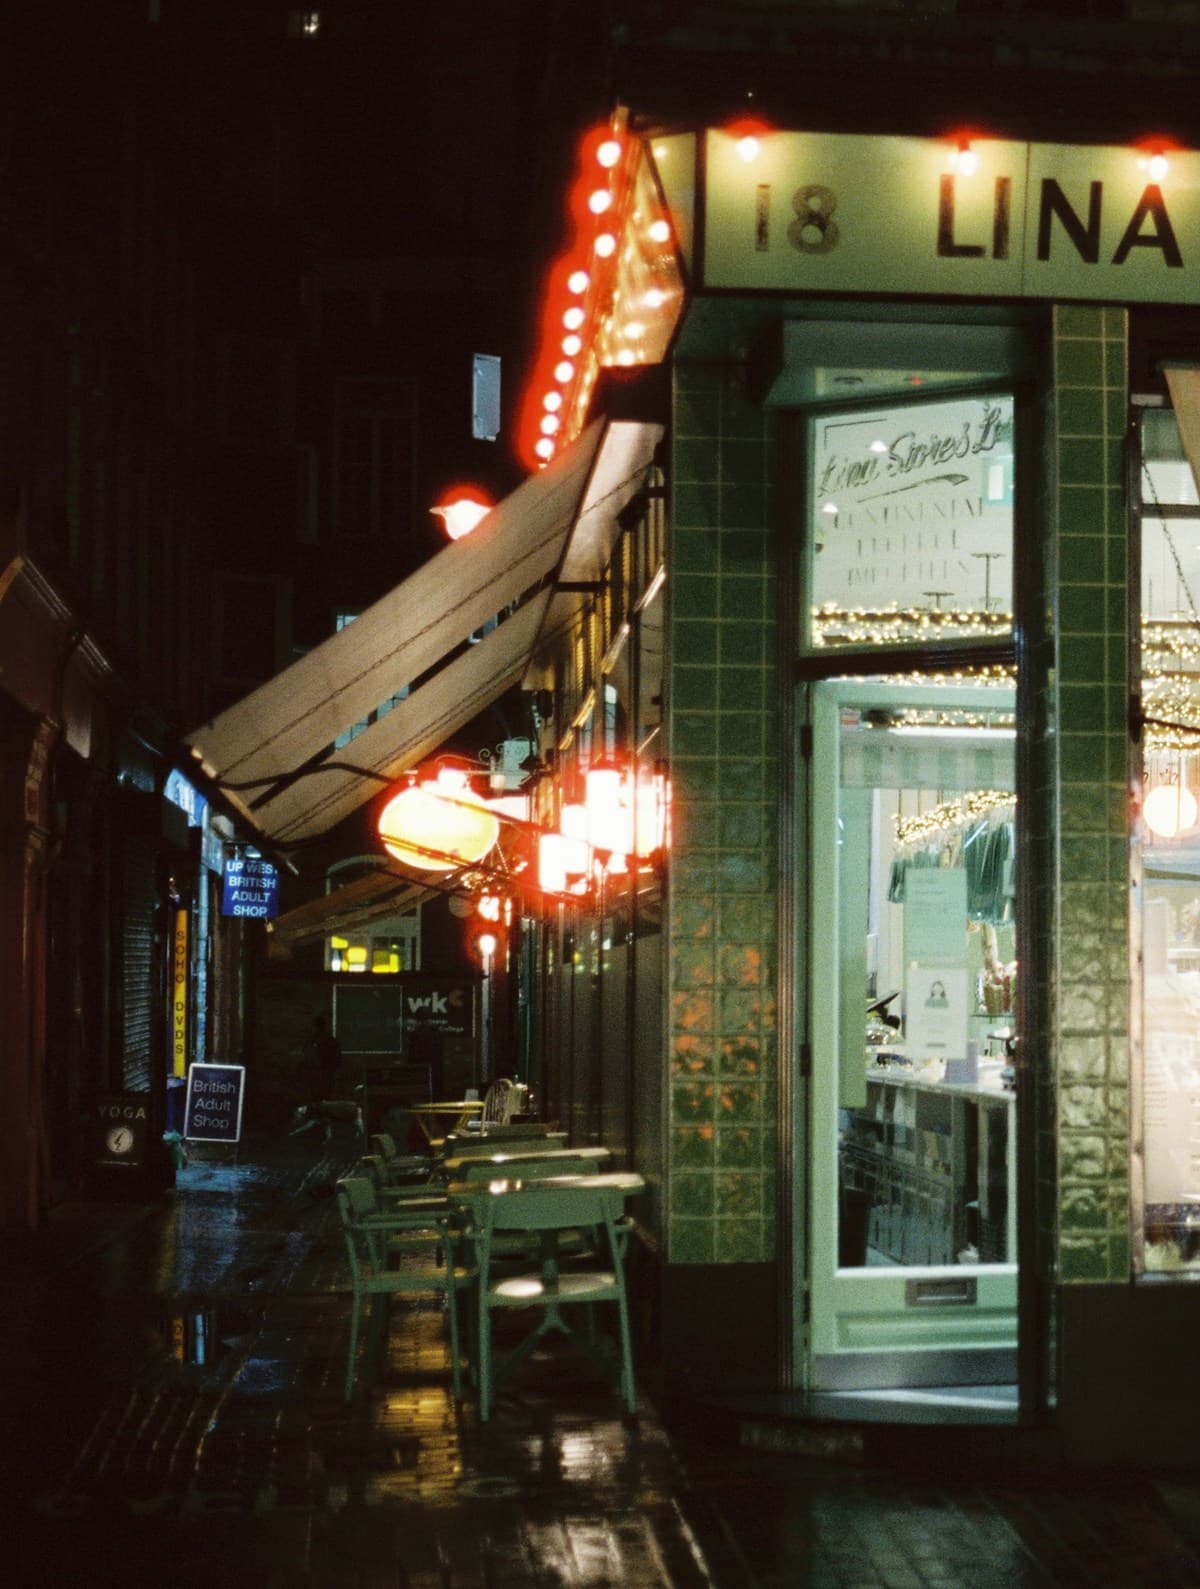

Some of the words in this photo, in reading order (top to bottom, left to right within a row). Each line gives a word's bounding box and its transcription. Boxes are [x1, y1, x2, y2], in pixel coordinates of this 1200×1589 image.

[754, 183, 841, 255] 18
[936, 173, 1185, 268] LINA
[226, 861, 244, 873] UP
[228, 875, 277, 889] BRITISH
[231, 890, 271, 903] ADULT
[232, 904, 268, 917] SHOP
[174, 931, 186, 984] SOHO
[174, 1001, 186, 1055] DVDS
[192, 1079, 236, 1094] British
[193, 1097, 232, 1112] Adult
[97, 1105, 147, 1120] YOGA
[192, 1114, 230, 1129] Shop
